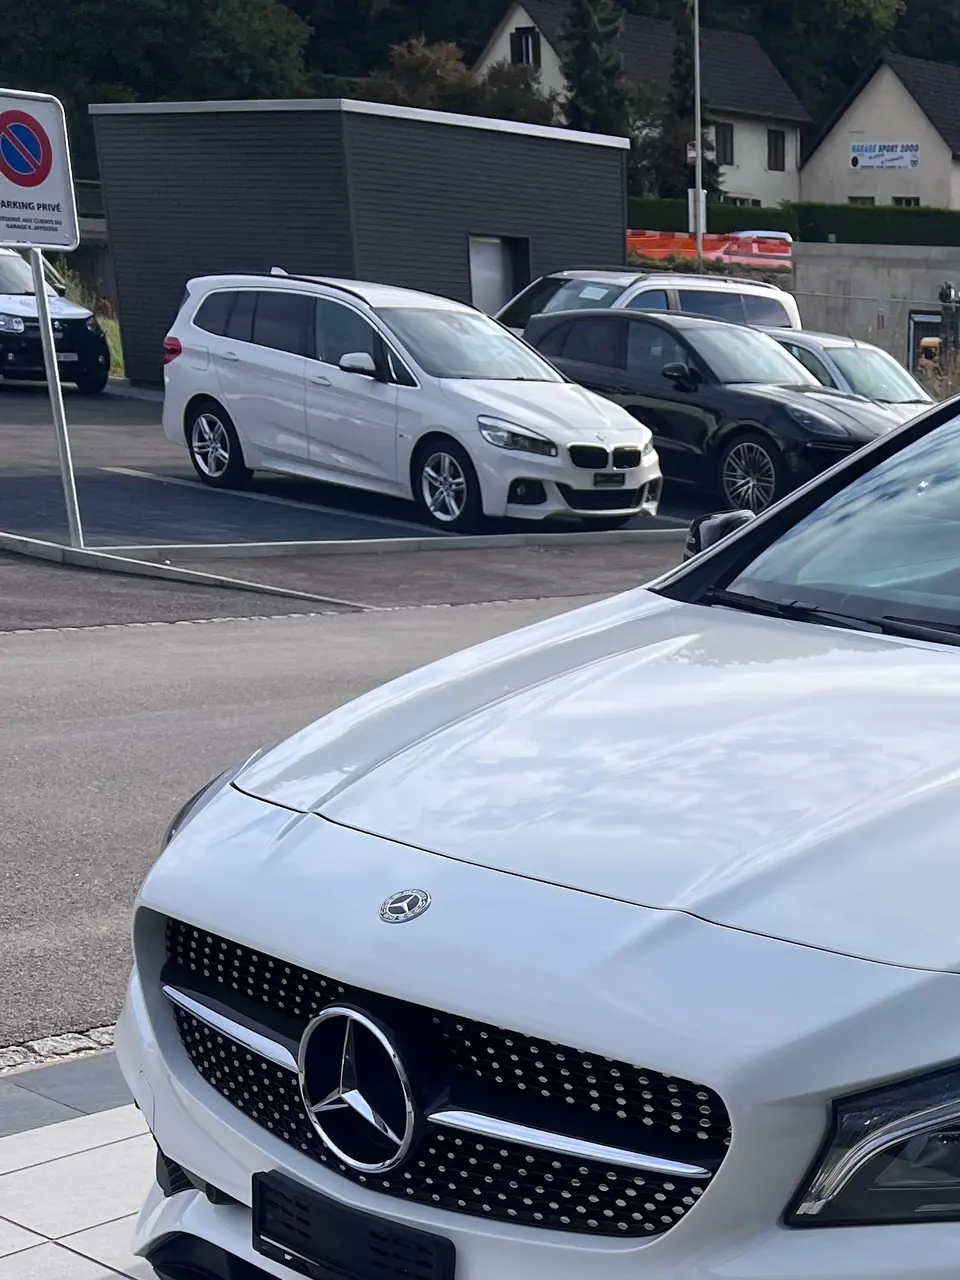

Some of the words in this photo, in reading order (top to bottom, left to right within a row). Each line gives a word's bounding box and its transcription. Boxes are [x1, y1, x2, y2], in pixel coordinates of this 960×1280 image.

[878, 144, 899, 152] SPORT
[0, 200, 35, 211] ARKING
[36, 202, 62, 213] PRIVÉ
